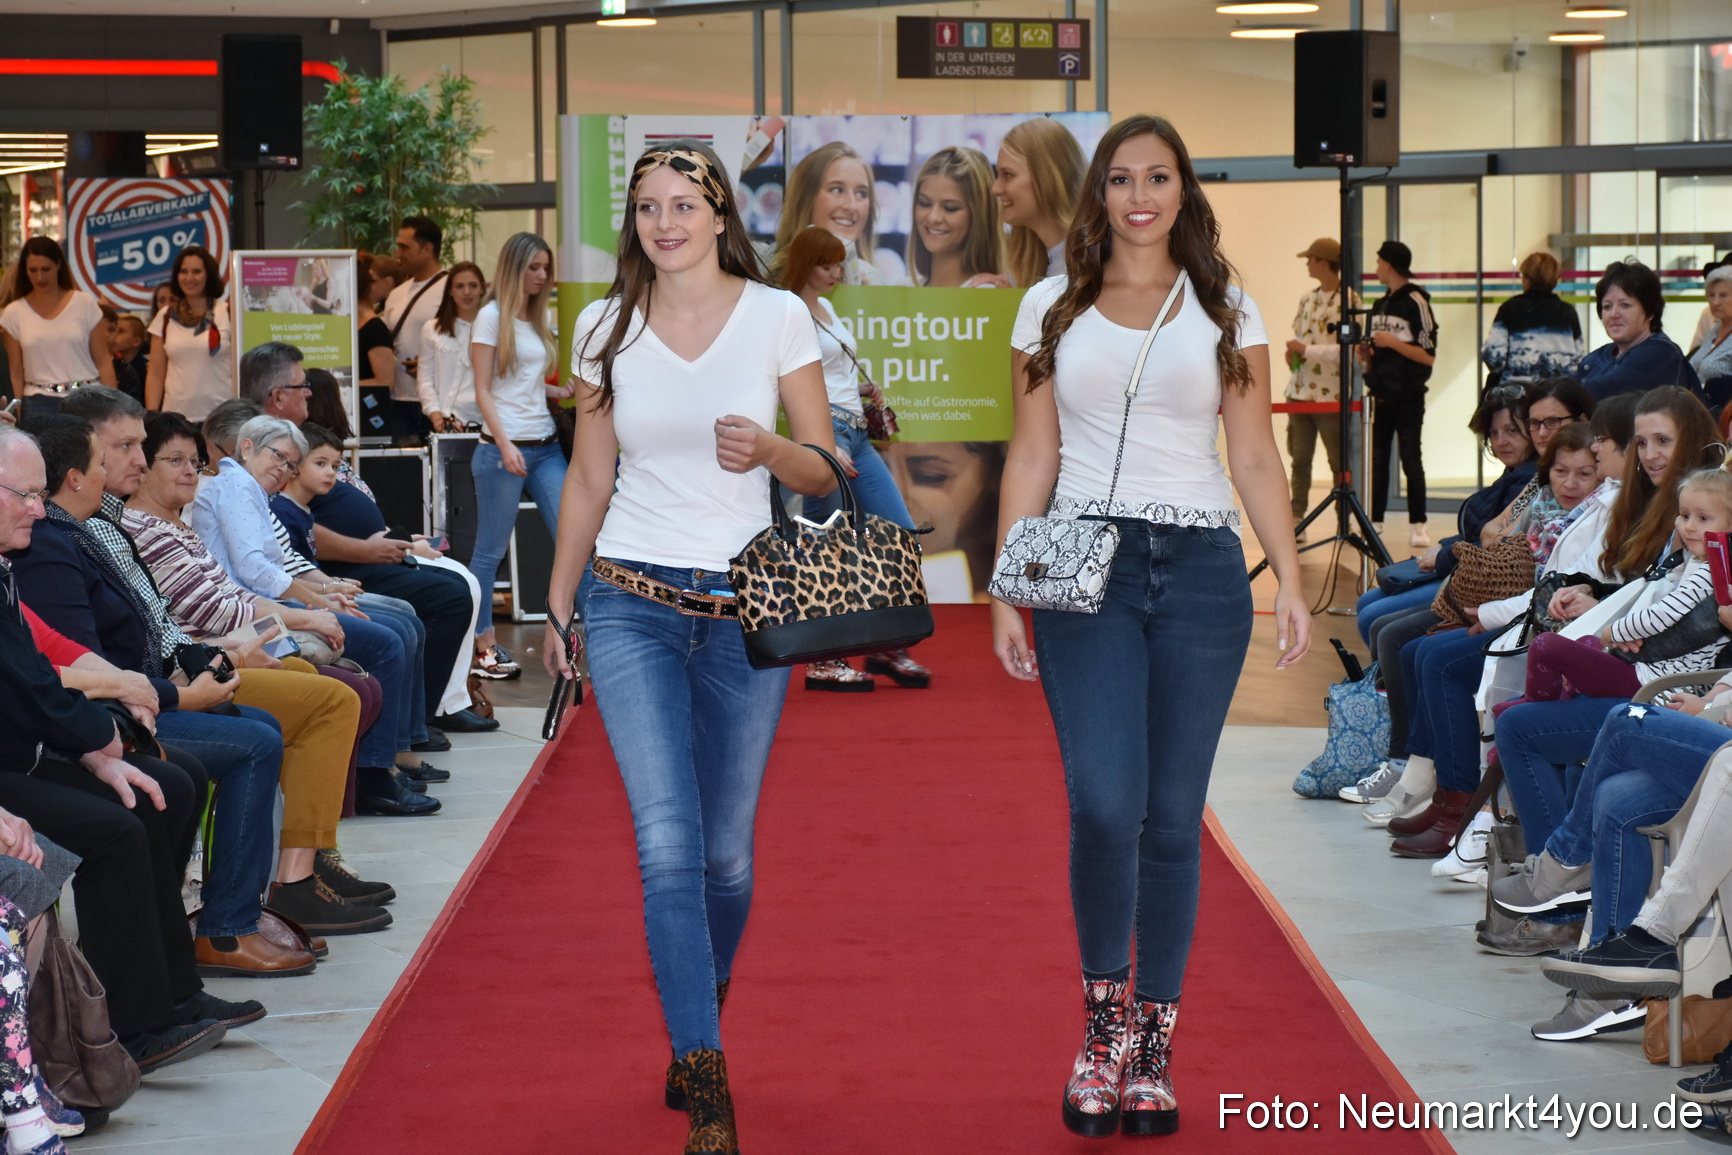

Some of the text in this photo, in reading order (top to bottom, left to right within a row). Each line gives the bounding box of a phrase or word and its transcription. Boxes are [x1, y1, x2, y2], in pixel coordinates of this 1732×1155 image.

[935, 52, 1016, 63] IN DER UNTEREN
[935, 65, 1015, 76] LADENSTRASSE
[284, 323, 325, 333] Lieblingsteil
[883, 357, 950, 388] pur.
[884, 395, 999, 408] häfte auf Gastronomie,
[895, 410, 973, 421] eden was dabei.
